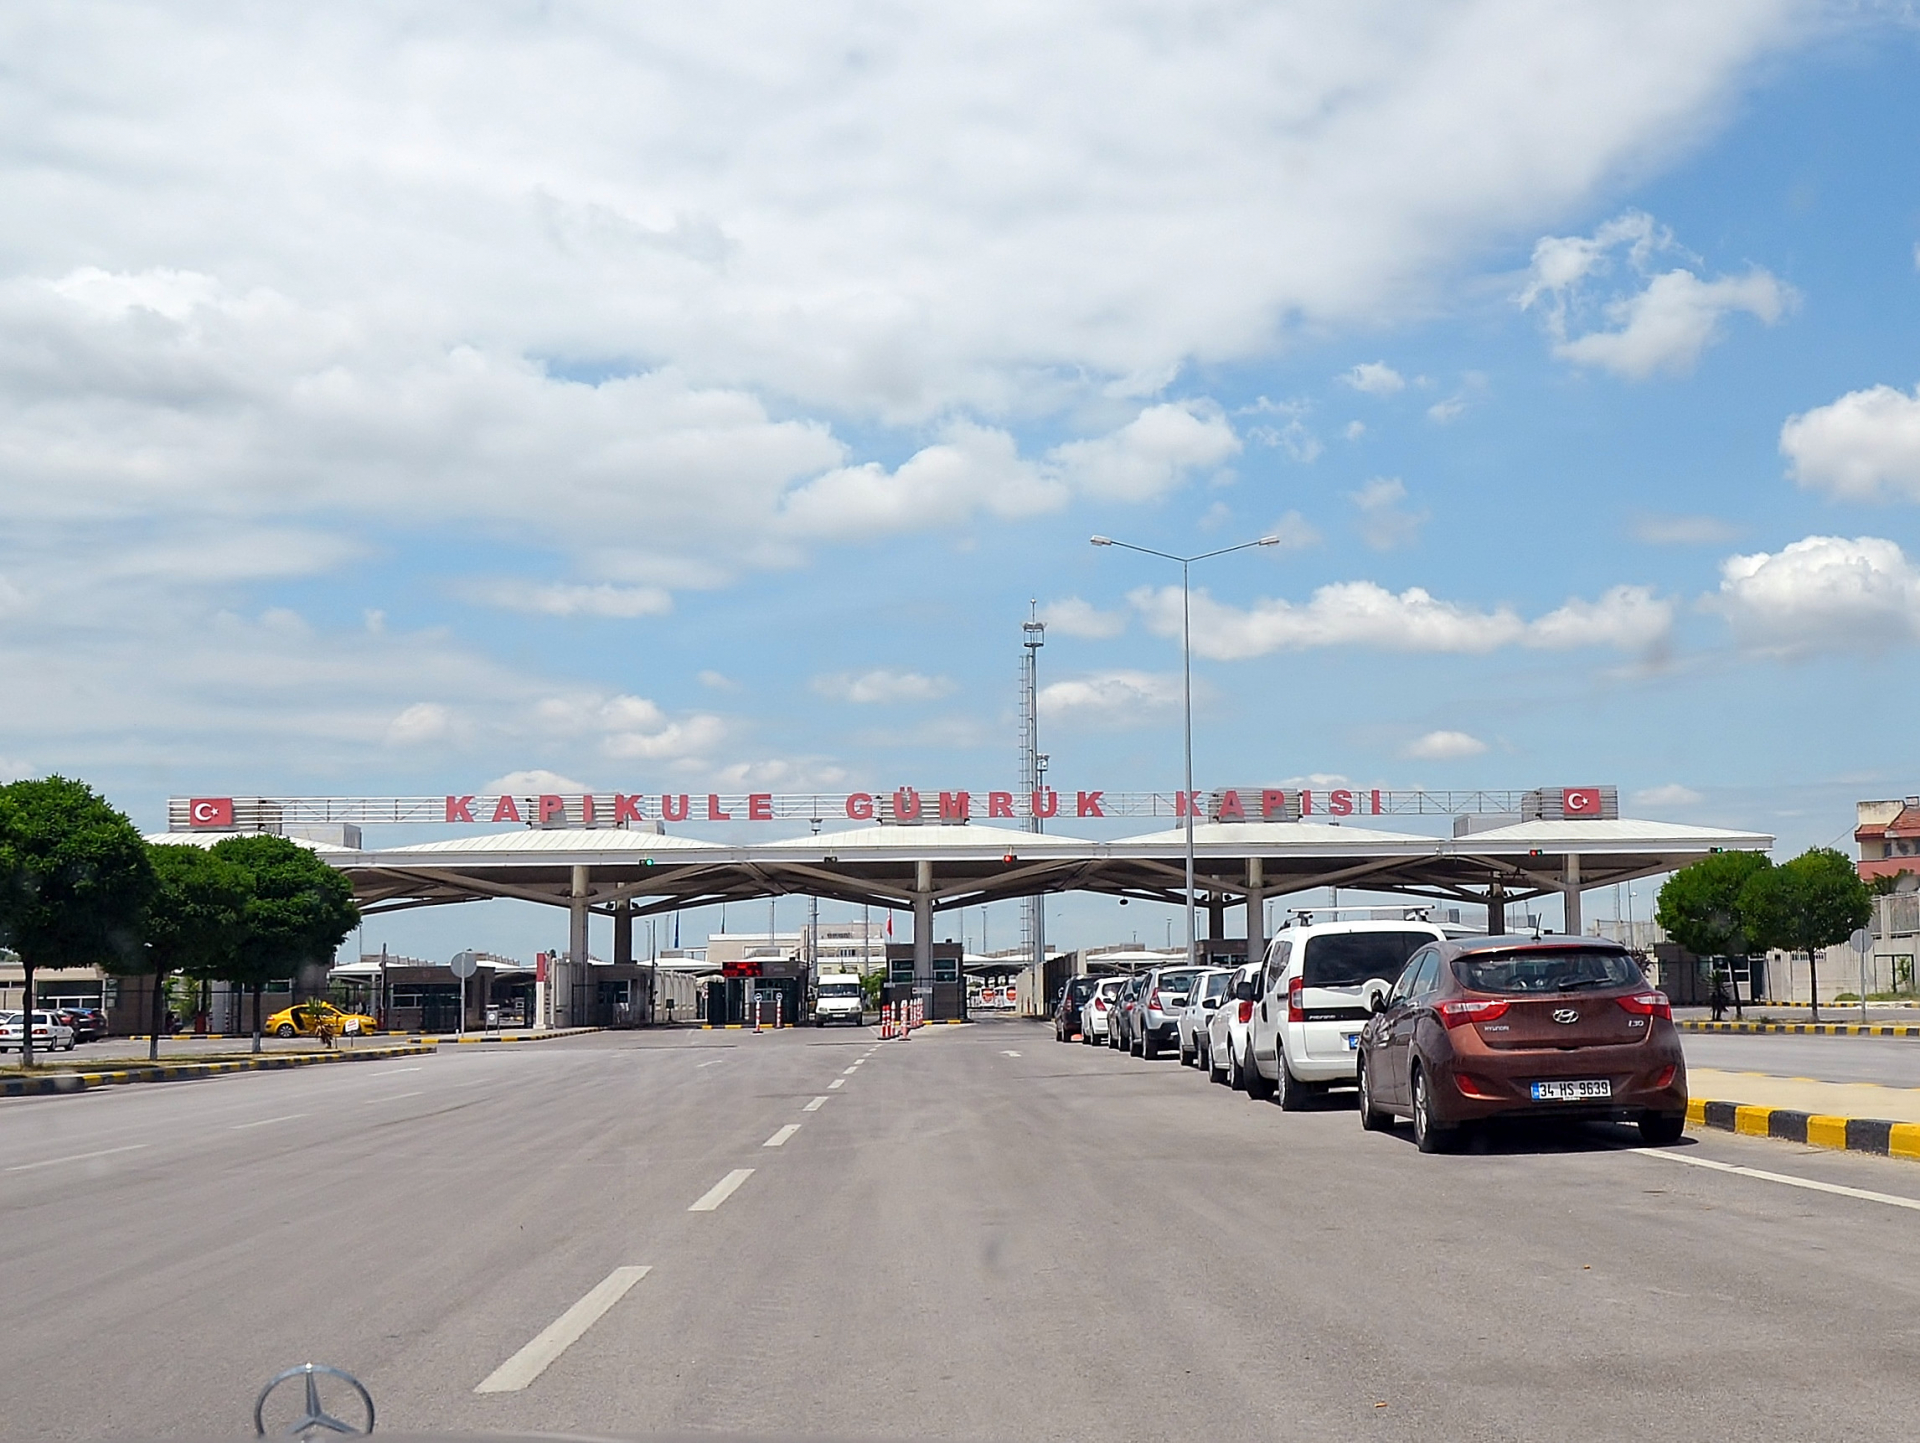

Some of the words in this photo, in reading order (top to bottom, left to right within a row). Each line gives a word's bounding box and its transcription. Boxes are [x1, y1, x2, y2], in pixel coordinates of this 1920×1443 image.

[446, 794, 773, 823] KAPIKULE
[846, 786, 1104, 821] GÜMRÜK
[1176, 789, 1380, 818] KAPISI
[1540, 1083, 1554, 1097] 34
[1559, 1082, 1574, 1096] HS
[1579, 1081, 1608, 1096] 9639
